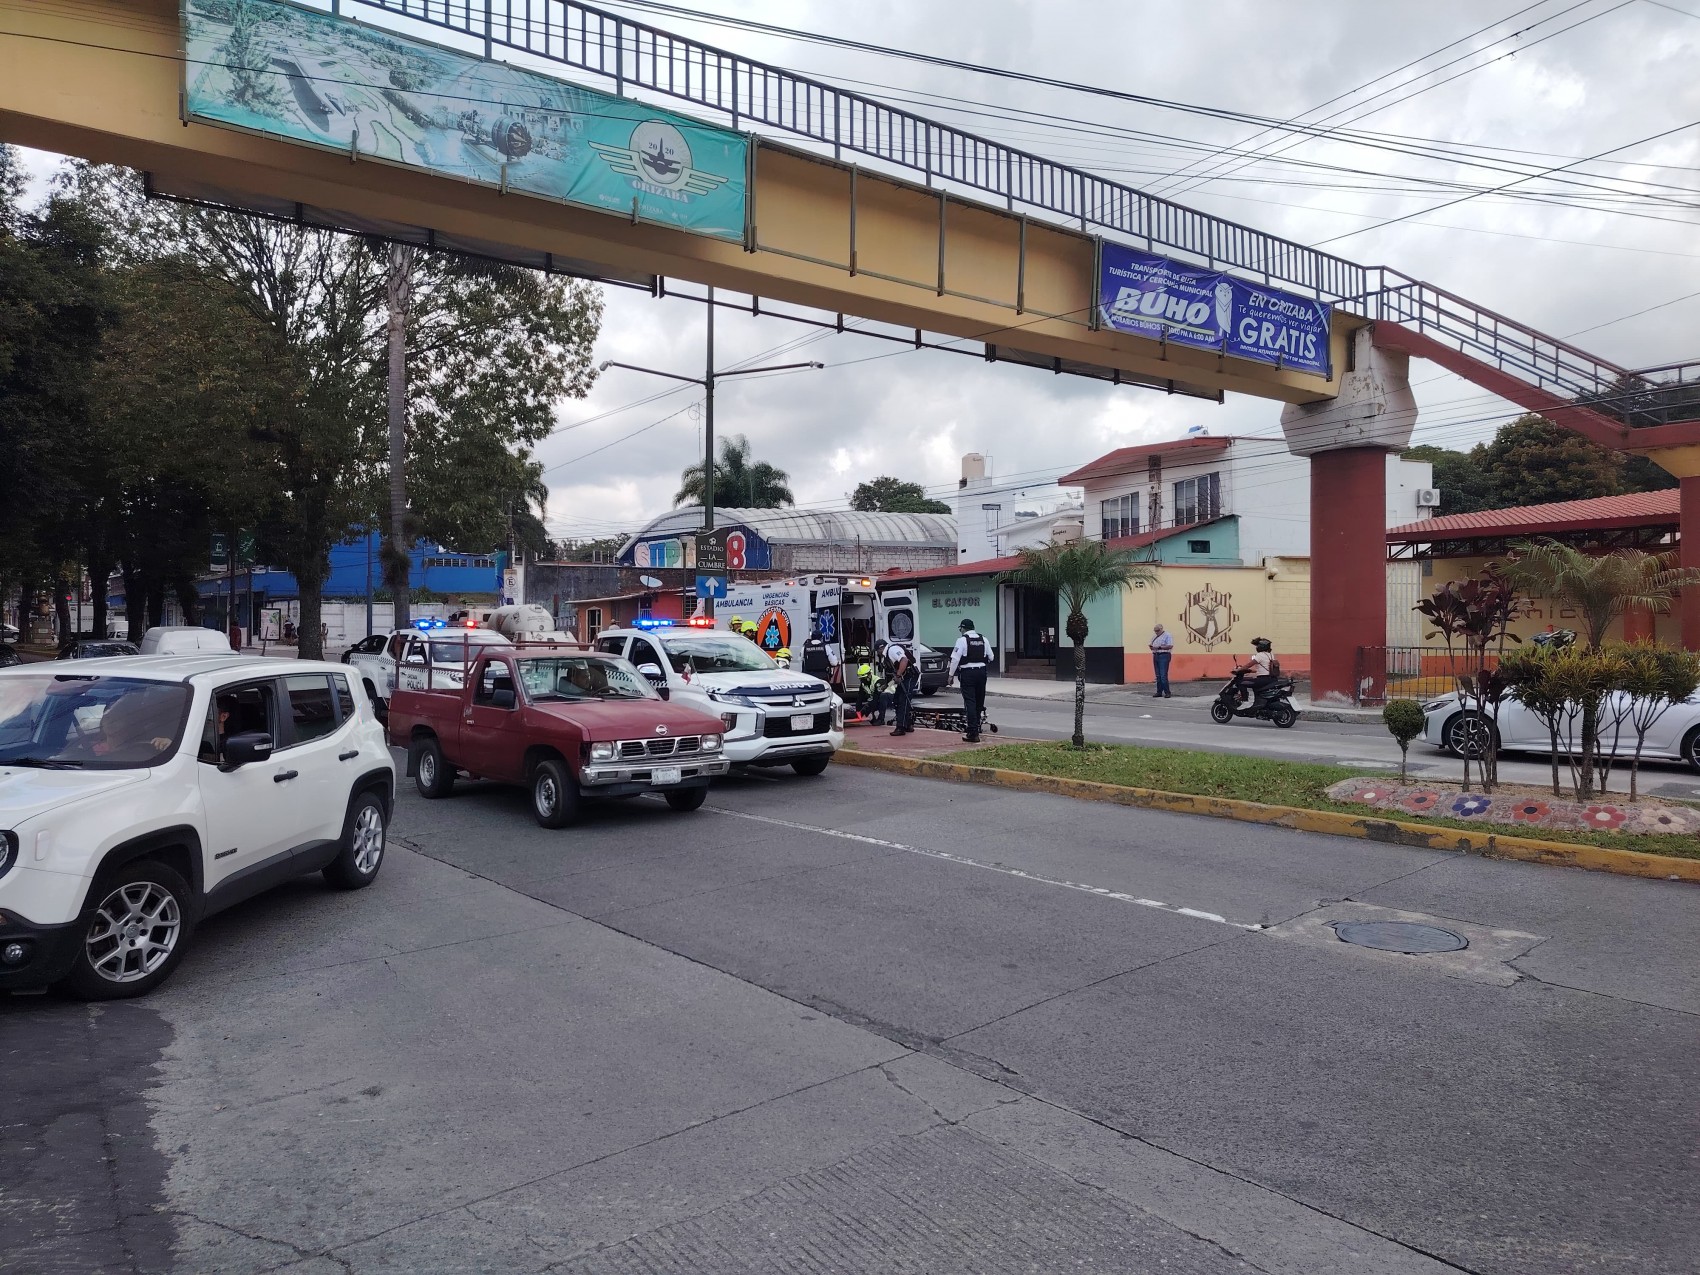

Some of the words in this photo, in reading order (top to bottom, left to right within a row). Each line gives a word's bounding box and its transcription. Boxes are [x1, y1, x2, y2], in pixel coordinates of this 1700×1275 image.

[632, 179, 689, 203] ORIZABA
[1109, 266, 1142, 281] TURÍSTICA
[1179, 284, 1213, 297] MUNICIPAL
[1131, 263, 1172, 278] TRANSPORTE
[1172, 273, 1180, 281] DE
[1114, 286, 1211, 325] BÚHO
[1249, 292, 1267, 308] EN
[1268, 298, 1313, 322] ORIZABA
[1111, 315, 1139, 327] HORARIOS
[1140, 320, 1160, 331] BÚHOS
[1180, 328, 1188, 337] PM
[1204, 334, 1215, 342] AM
[1238, 304, 1247, 314] Te
[1249, 308, 1287, 324] queremos
[1288, 320, 1299, 328] ver
[1300, 320, 1322, 333] viajar
[1239, 317, 1317, 359] GRATIS
[700, 544, 724, 552] ESTADIO
[698, 561, 726, 569] CUMBRE
[715, 598, 753, 608] AMBULANCIA
[762, 591, 790, 600] URGENCIAS
[931, 598, 943, 608] EL
[944, 596, 981, 608] CASTOR
